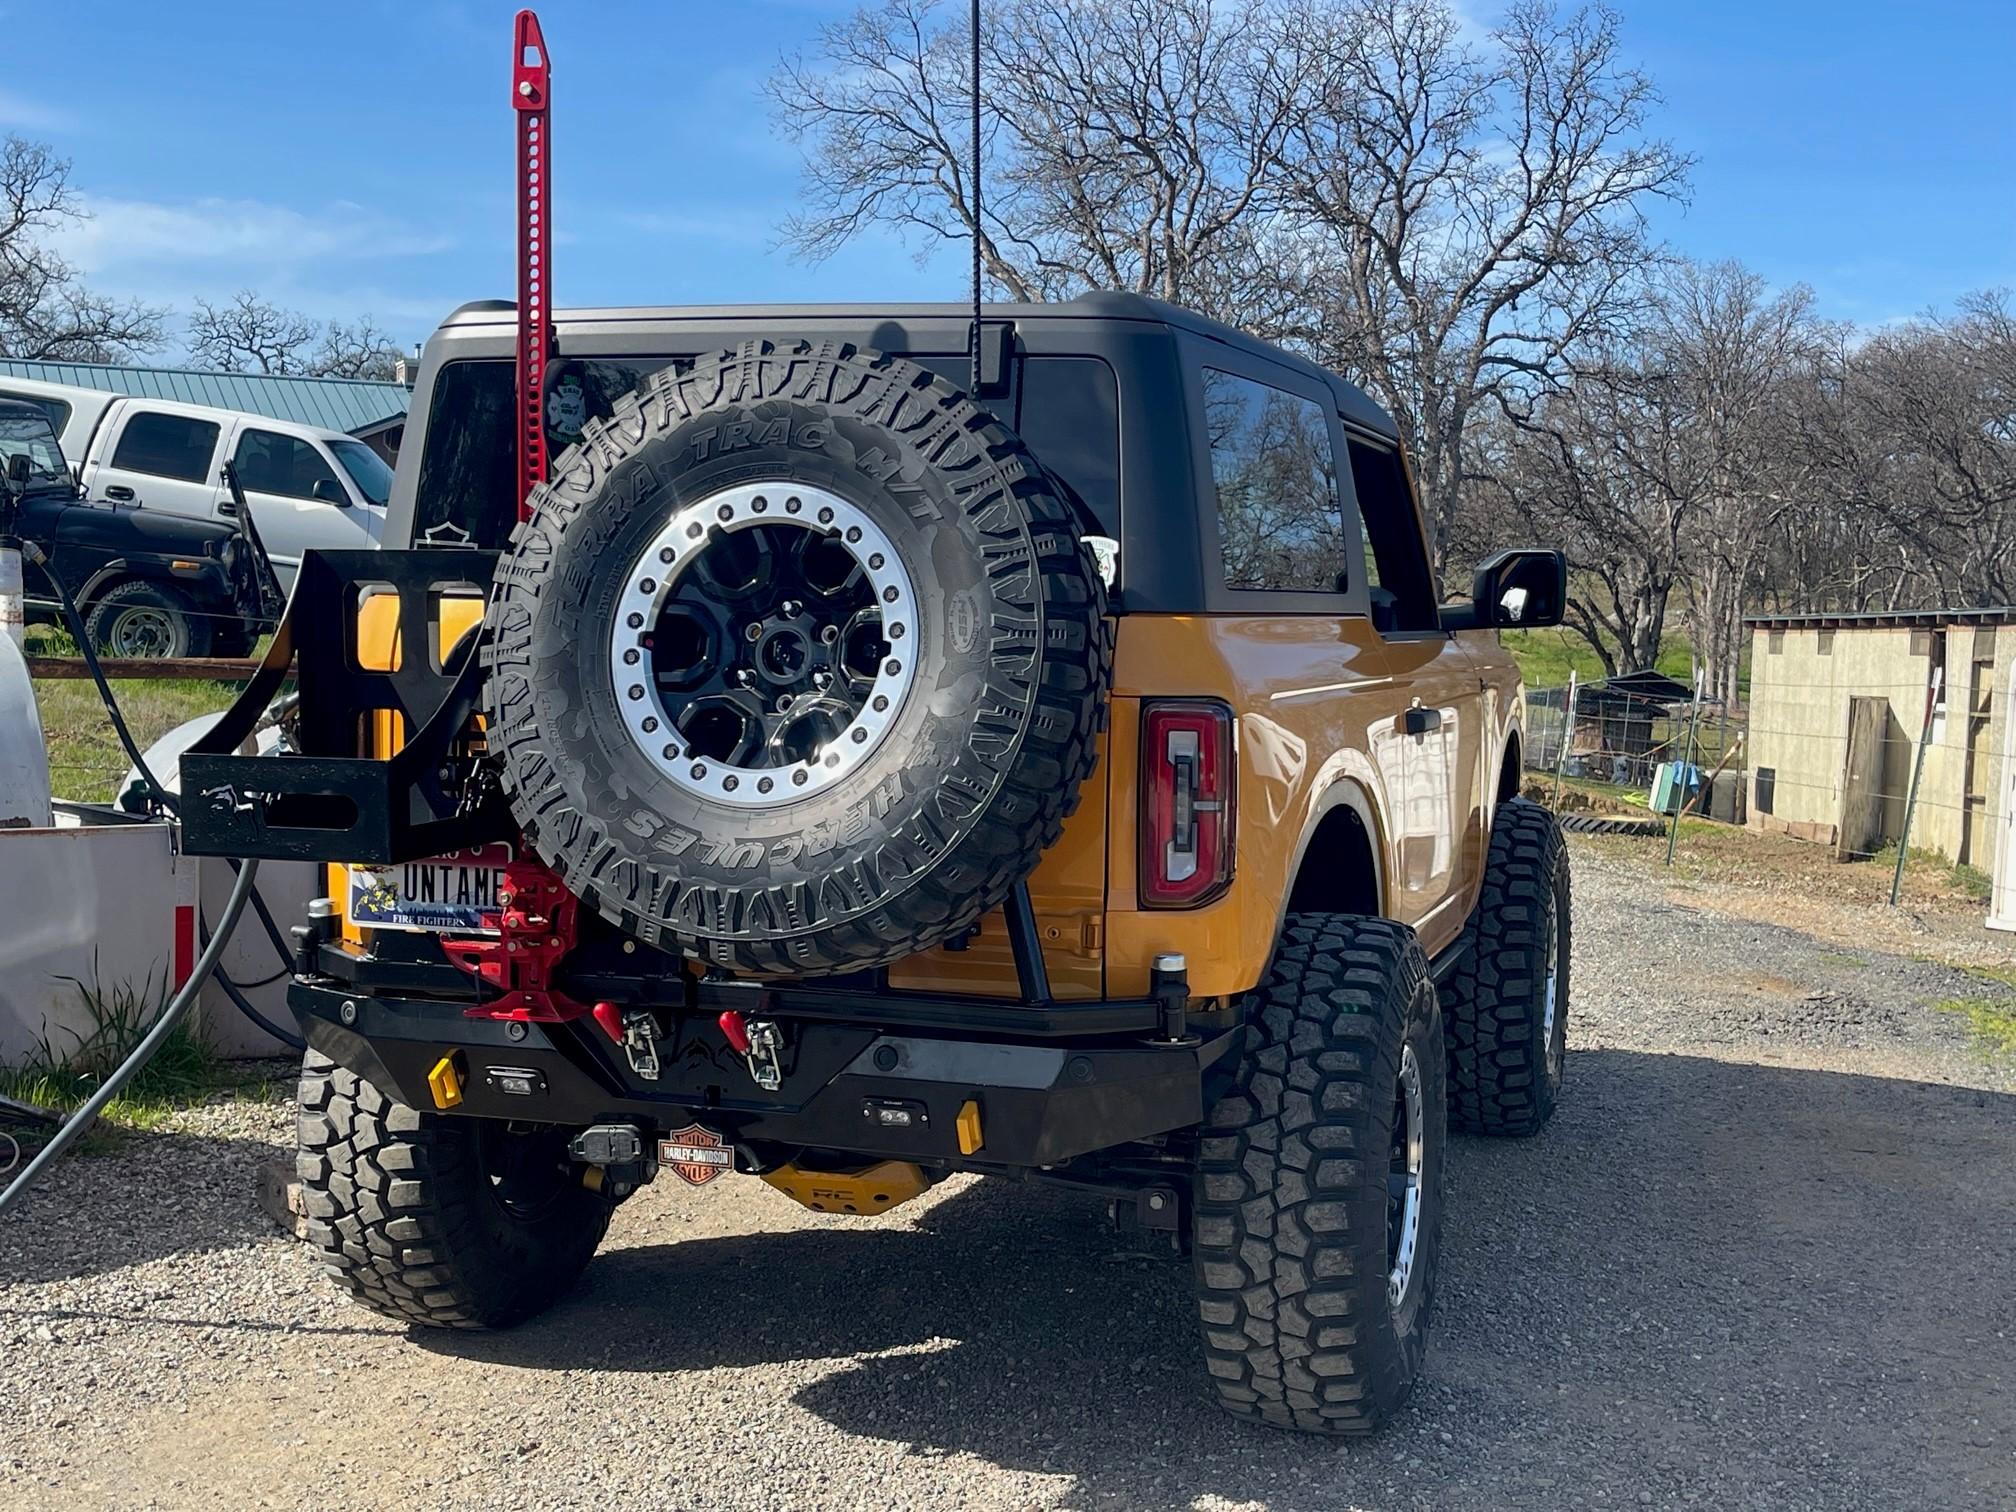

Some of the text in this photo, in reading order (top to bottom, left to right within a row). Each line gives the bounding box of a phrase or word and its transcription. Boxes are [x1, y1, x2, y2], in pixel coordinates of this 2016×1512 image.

[552, 461, 659, 632] TERRA
[691, 417, 832, 461] TRAC
[855, 446, 944, 521] M/T
[622, 770, 906, 869] HERCULES
[393, 914, 466, 927] FIRE FIGHTERS
[679, 1132, 714, 1147] MOTOR
[664, 1146, 728, 1164] HARLEY-DAVIDSON
[679, 1163, 714, 1181] CYCLES
